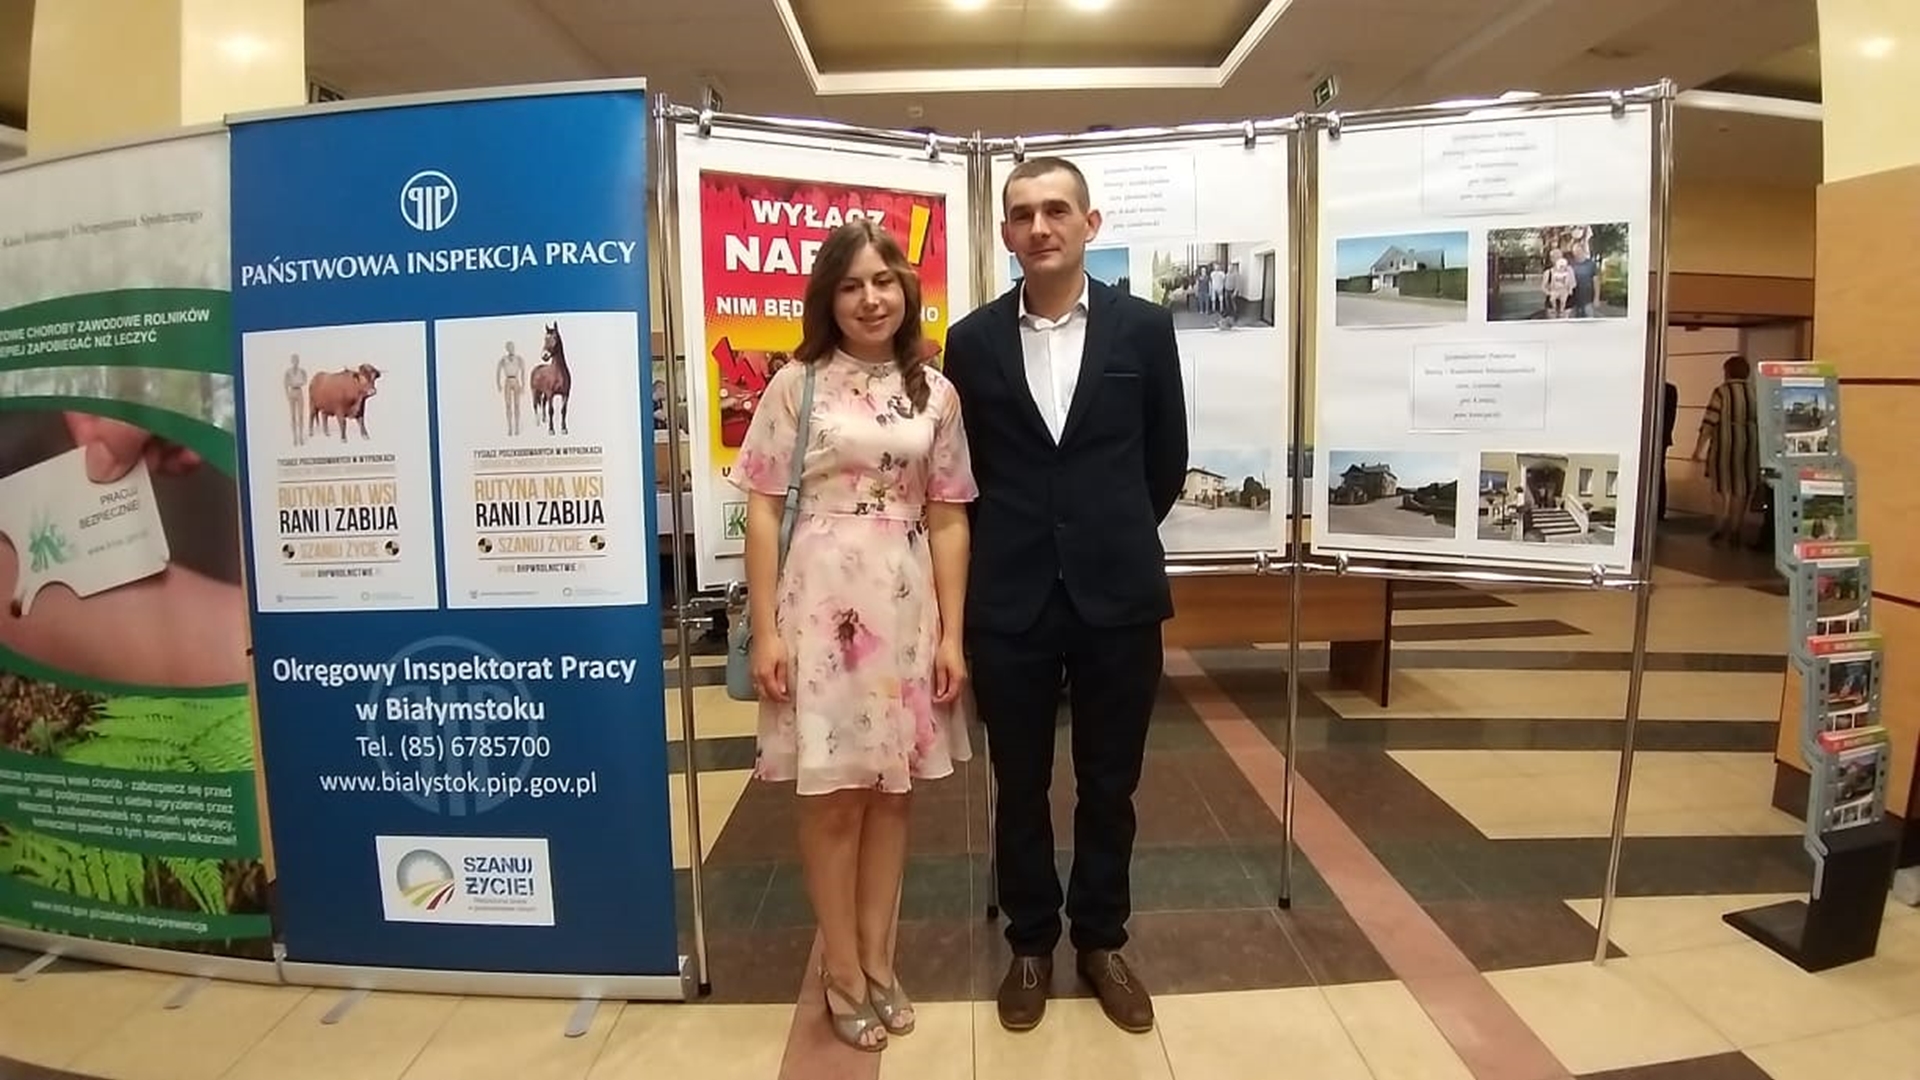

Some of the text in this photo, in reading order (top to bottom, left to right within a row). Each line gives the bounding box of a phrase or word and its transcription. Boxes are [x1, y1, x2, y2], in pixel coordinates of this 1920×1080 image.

[241, 240, 637, 287] PAŃSTWOWA INSPEKCJA PRACY
[715, 296, 757, 316] NIM
[26, 322, 75, 339] CHOROBY
[77, 314, 141, 332] ZAWODOWE
[143, 308, 210, 325] ROLNIKÓW
[27, 334, 92, 355] ZAPOBIEGAĆ
[94, 332, 112, 348] NIŻ
[114, 329, 157, 346] LECZYĆ
[278, 481, 398, 508] RUTYNA NA WSI
[474, 477, 604, 501] RUTYNA NA WSI
[279, 506, 399, 534] RANI I ZABIJA
[476, 499, 605, 527] RANI I ZABIJA
[272, 654, 637, 686] Okręgowy Inspektorat Pracy
[355, 696, 545, 726] w Białymstoku
[356, 735, 550, 761] Tel. (85) 6785700
[203, 785, 232, 798] przed
[319, 771, 597, 797] www.bialystok.pip.gov.pl
[463, 857, 532, 873] SZANUJ
[464, 877, 534, 896] ŻYCIE!
